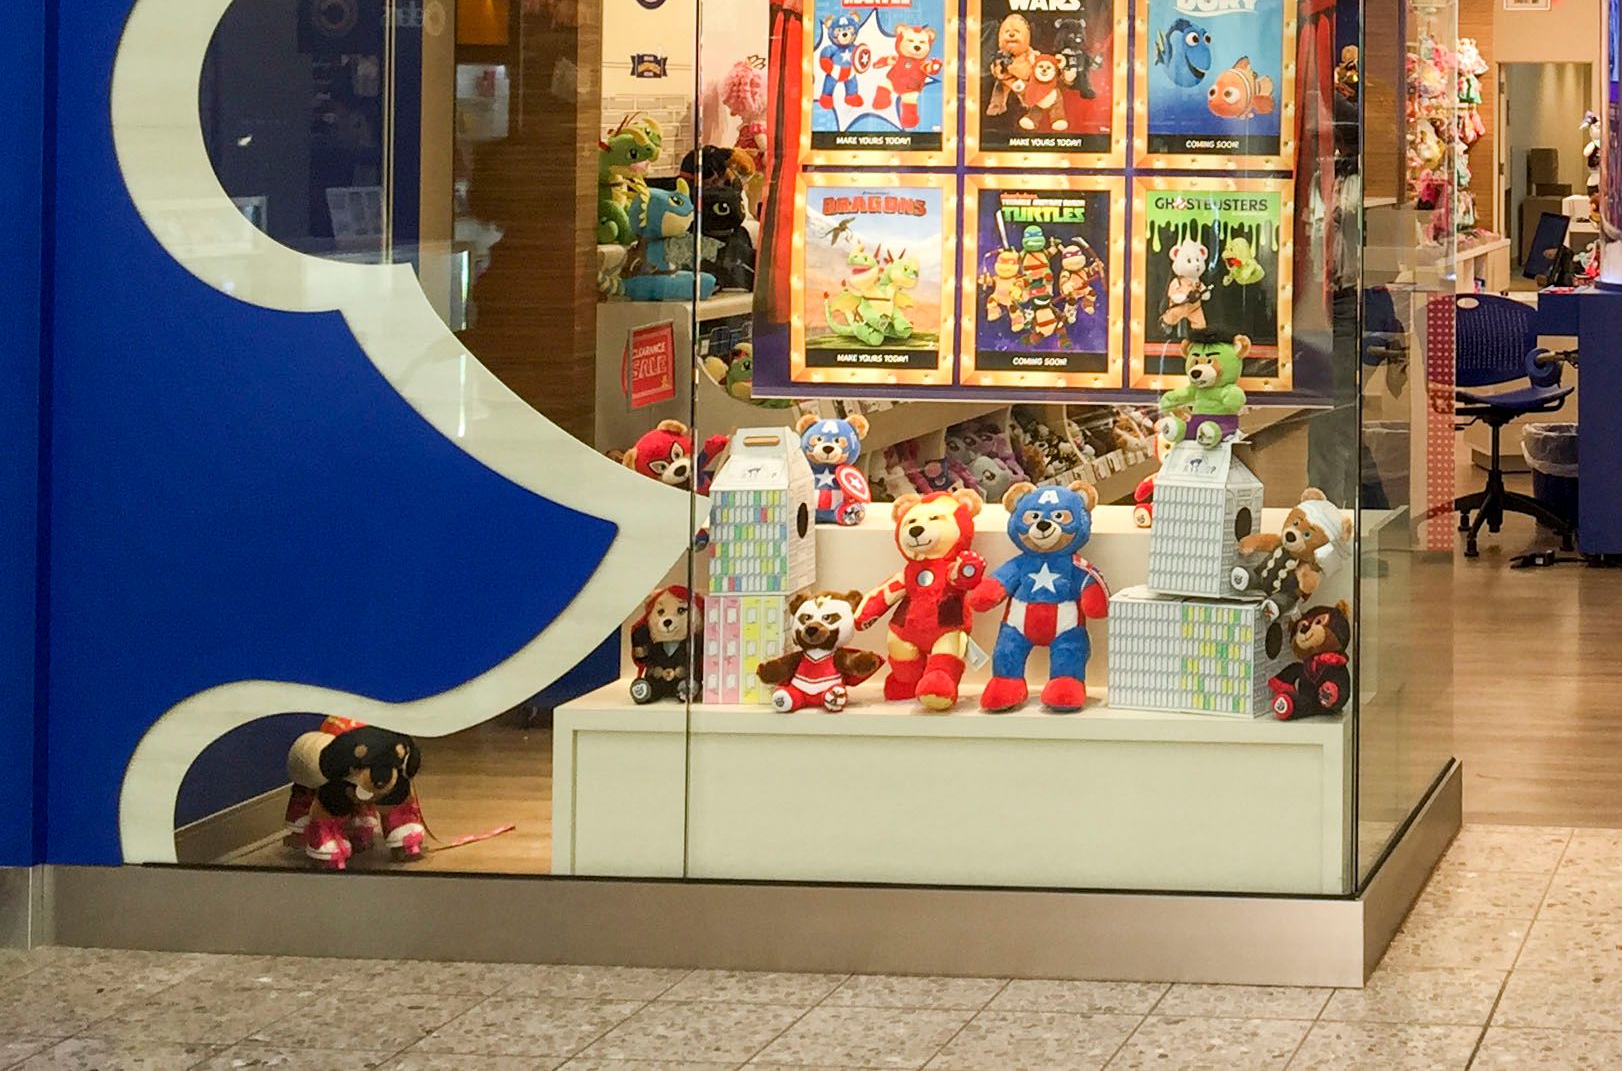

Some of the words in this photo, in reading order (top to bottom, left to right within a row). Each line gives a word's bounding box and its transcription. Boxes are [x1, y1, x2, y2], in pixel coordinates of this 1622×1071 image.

[836, 136, 858, 145] MAKE
[1009, 137, 1030, 146] MAKE
[822, 195, 927, 217] DRAGONS
[1001, 206, 1086, 223] TURTLES
[836, 353, 858, 363] MAKE
[1012, 356, 1043, 366] COMING
